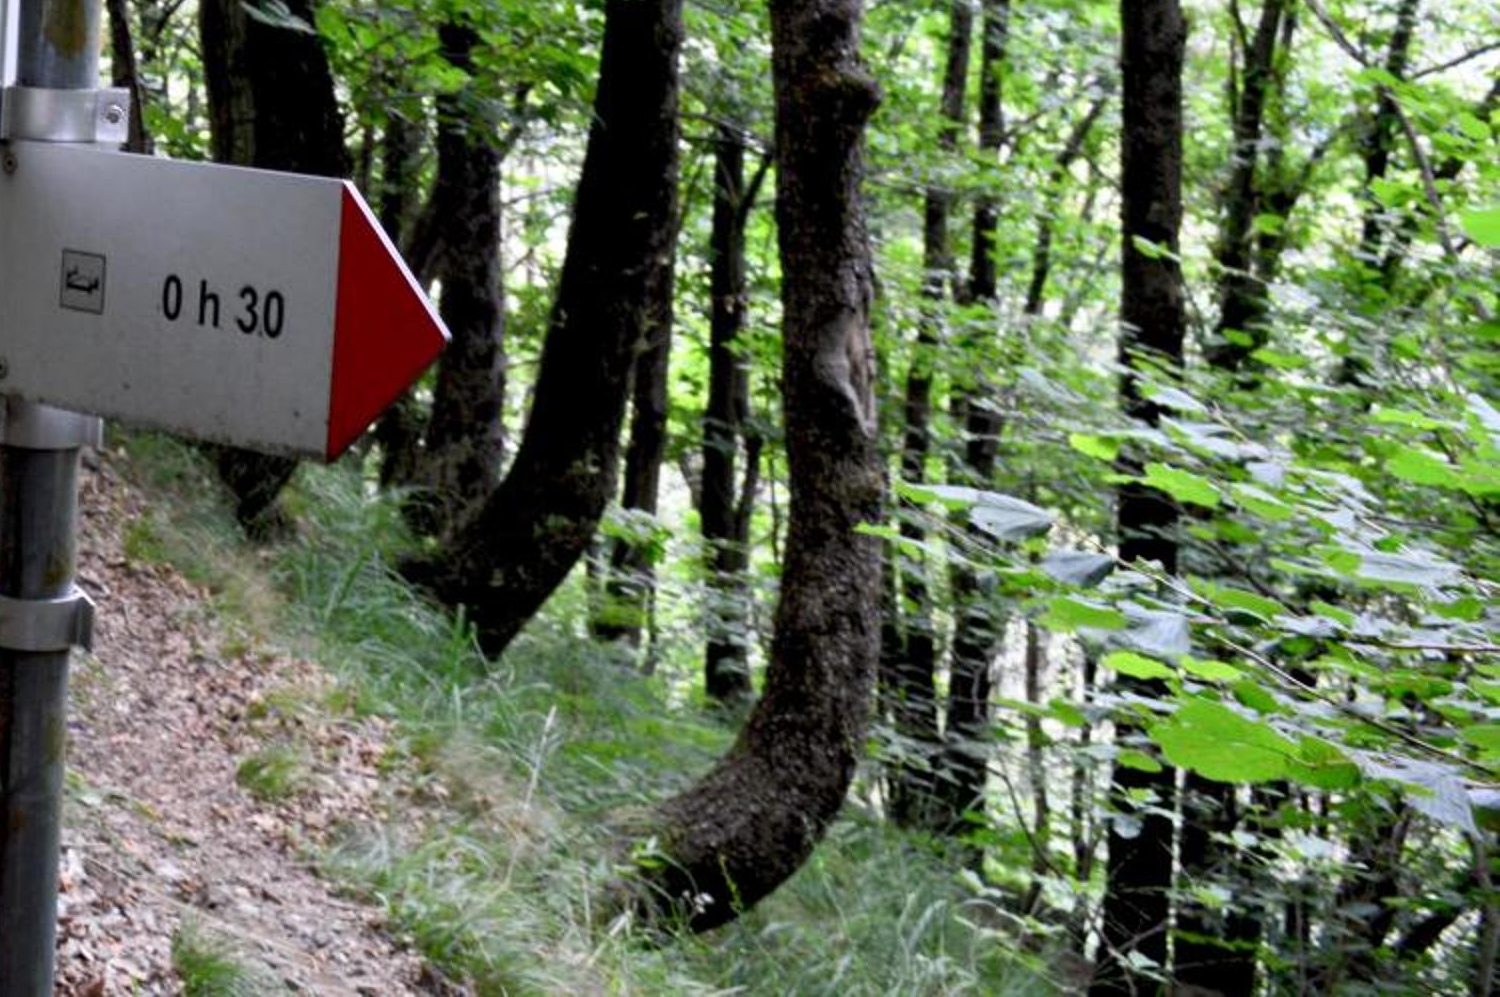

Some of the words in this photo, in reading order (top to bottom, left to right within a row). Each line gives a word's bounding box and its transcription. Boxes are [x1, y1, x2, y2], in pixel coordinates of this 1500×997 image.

[161, 273, 184, 322] 0
[197, 278, 220, 328] h
[235, 284, 286, 339] 30
